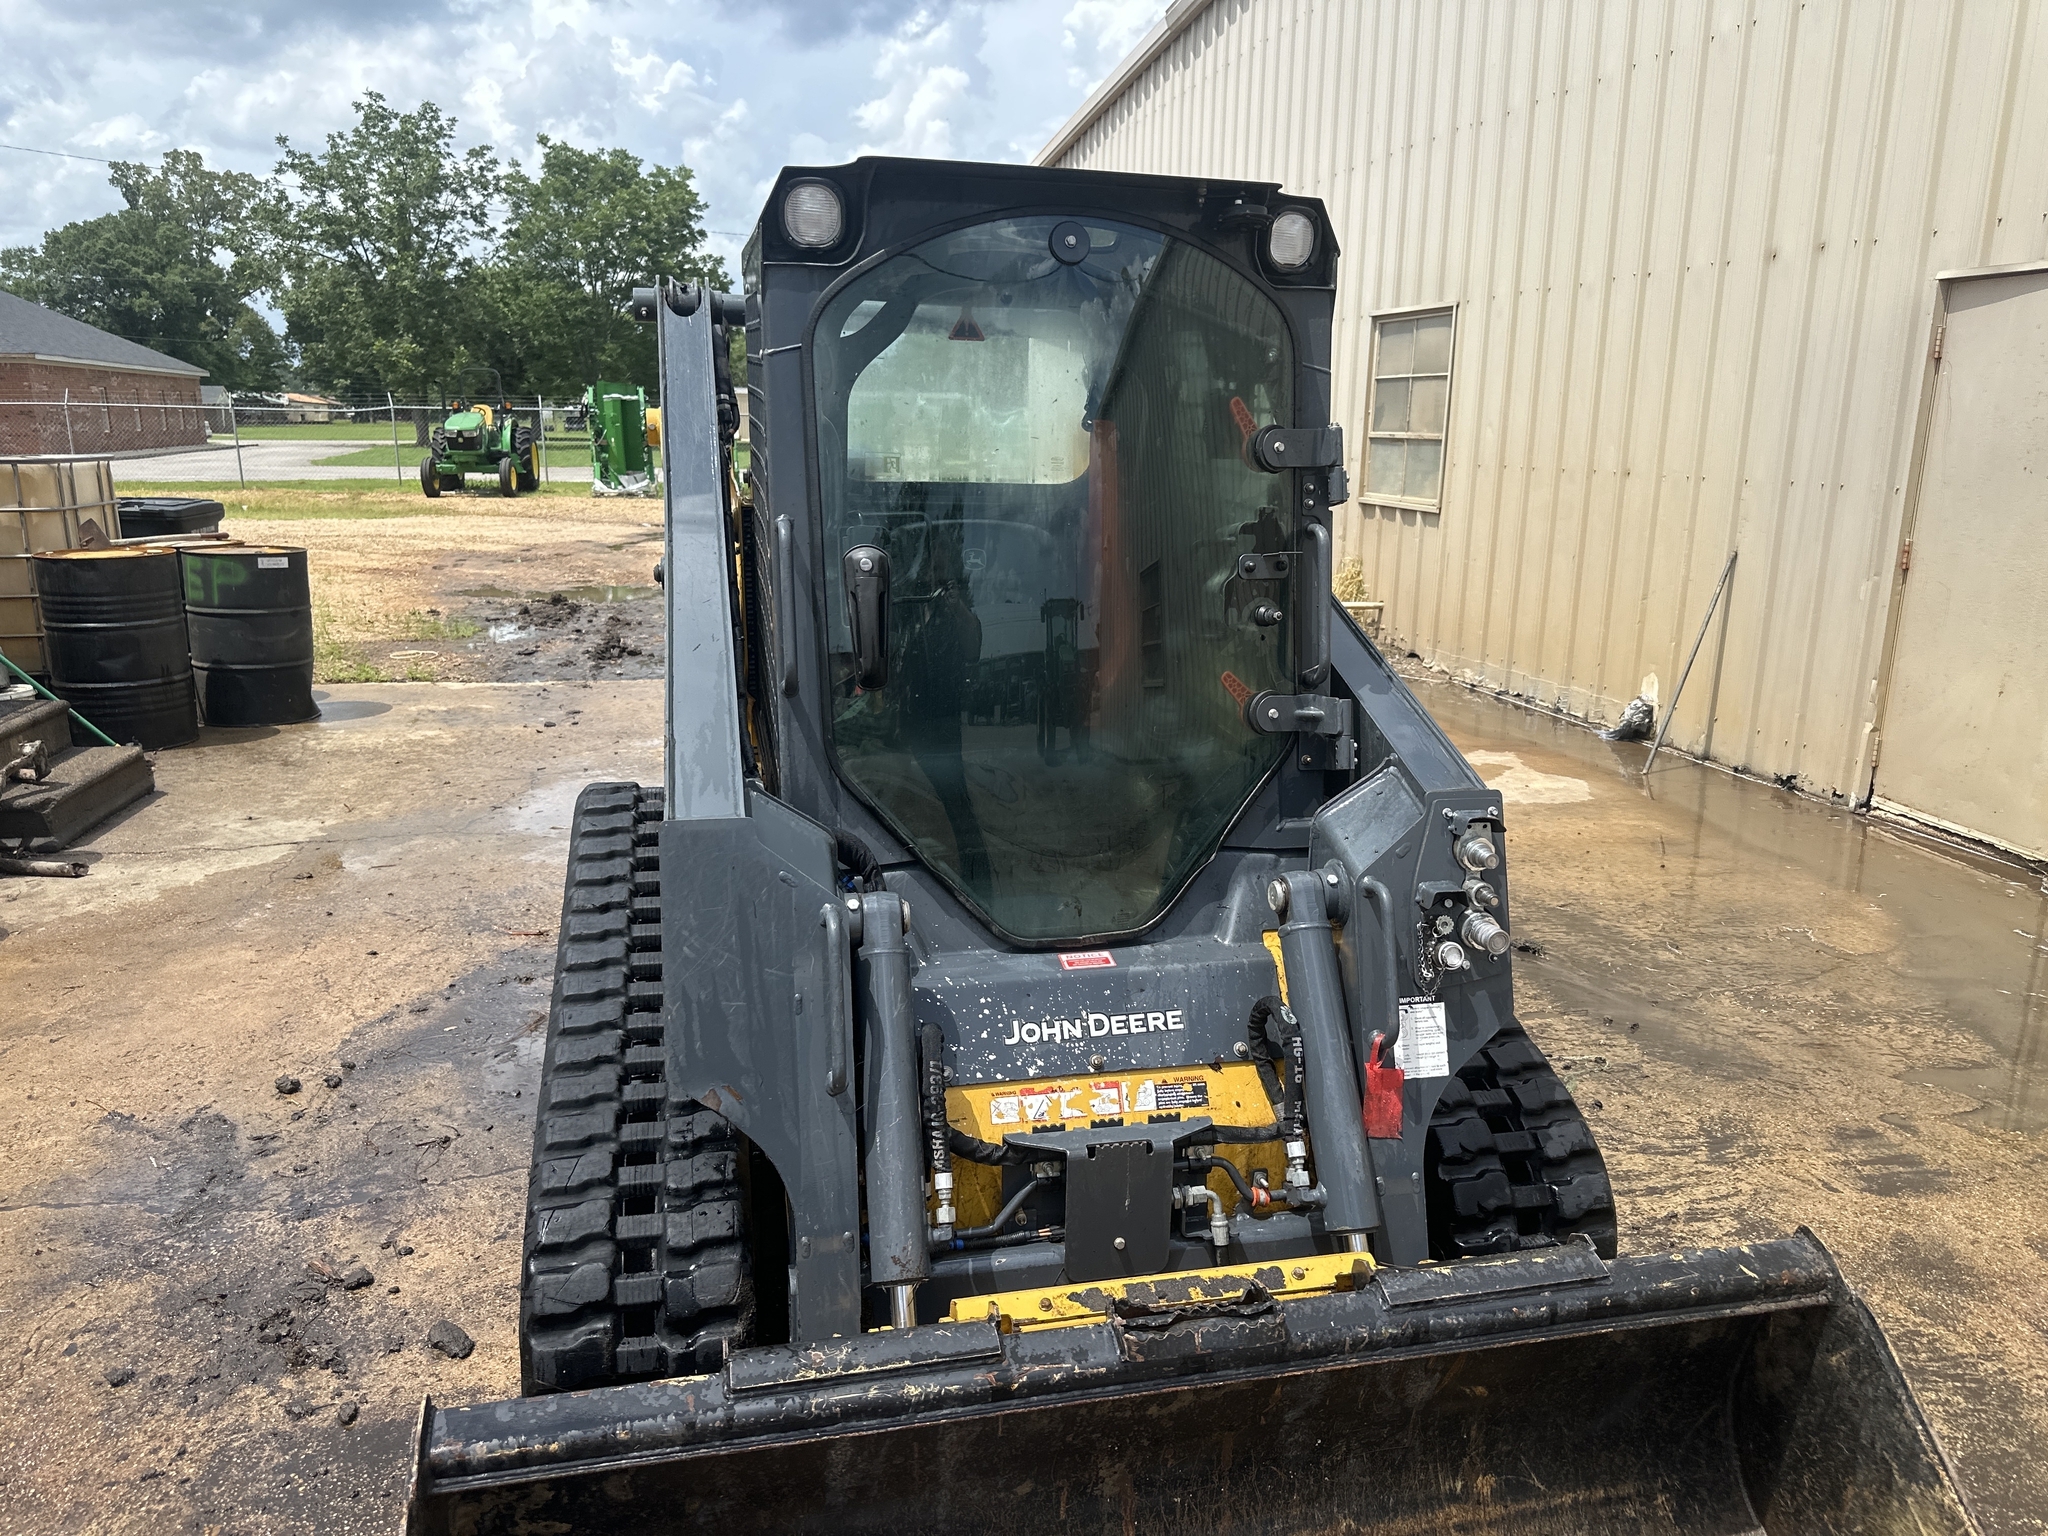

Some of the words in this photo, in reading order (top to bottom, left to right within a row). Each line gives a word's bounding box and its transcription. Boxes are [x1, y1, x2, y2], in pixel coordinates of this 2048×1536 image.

[1398, 995, 1436, 1004] IMPORTANT
[1004, 1018, 1083, 1046] JOHN
[1088, 1009, 1185, 1038] DEERE
[1173, 1074, 1205, 1083] WARNING
